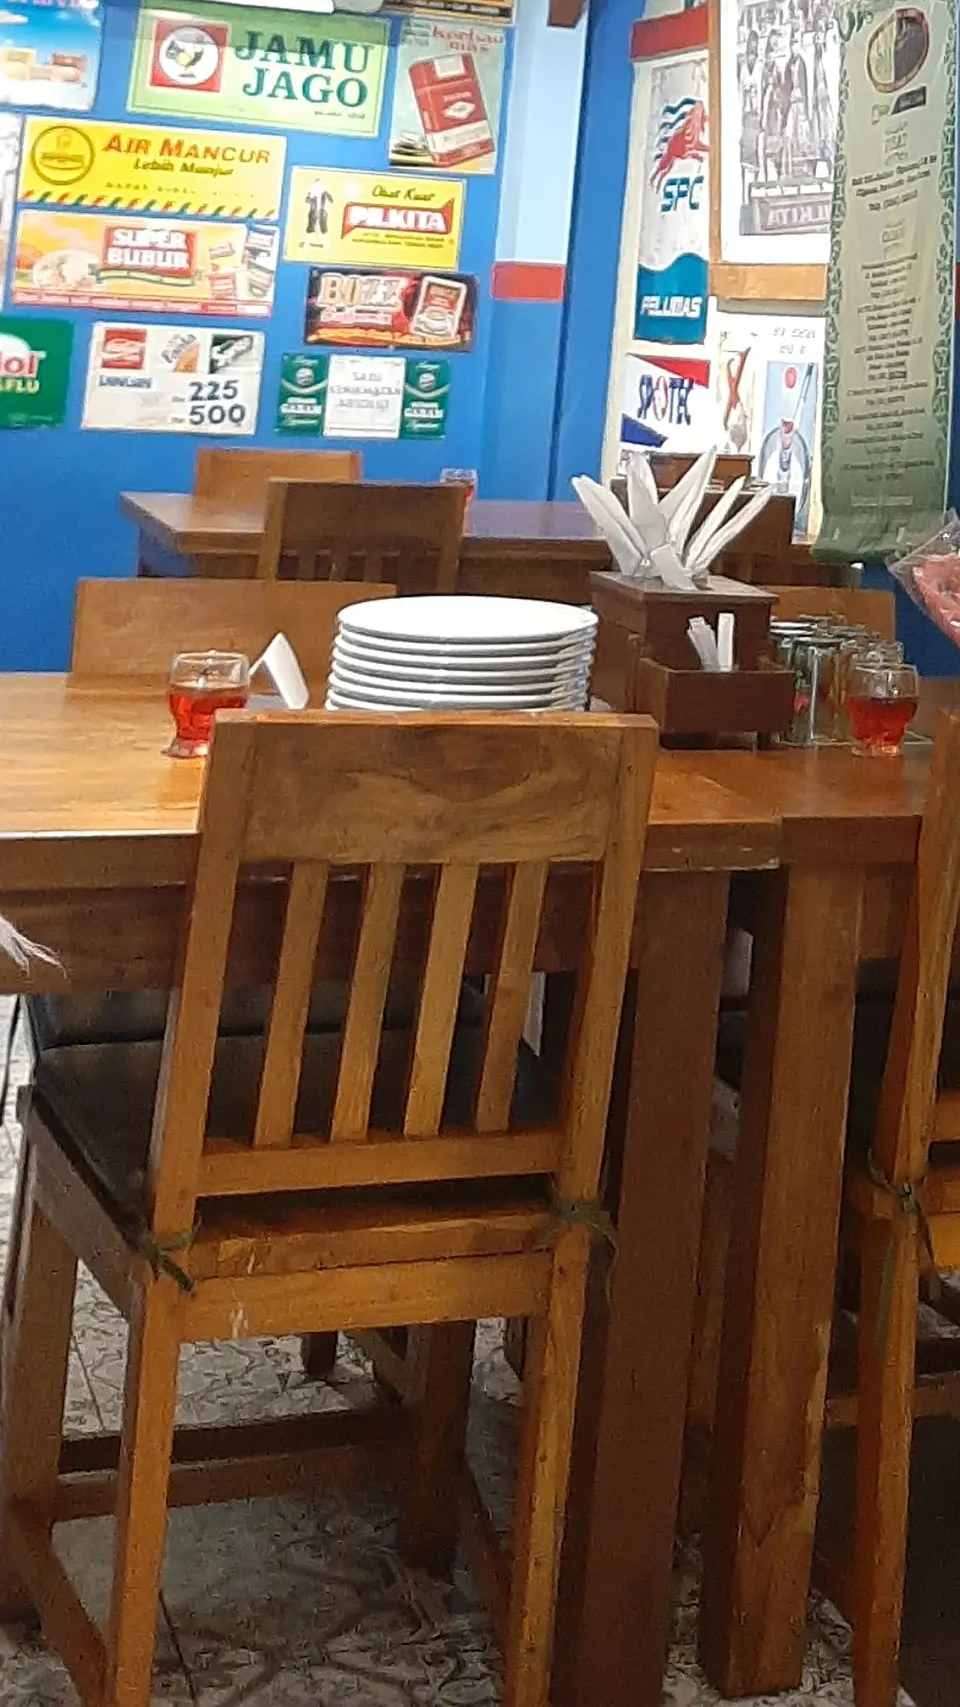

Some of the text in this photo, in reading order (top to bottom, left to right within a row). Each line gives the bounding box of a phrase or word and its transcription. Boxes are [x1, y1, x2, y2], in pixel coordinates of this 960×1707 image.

[235, 30, 374, 74] JAMU
[243, 67, 368, 107] JAGO
[104, 133, 270, 163] AIR MANCUR
[660, 177, 704, 212] SPC
[189, 380, 239, 401] 225
[189, 404, 246, 425] 500
